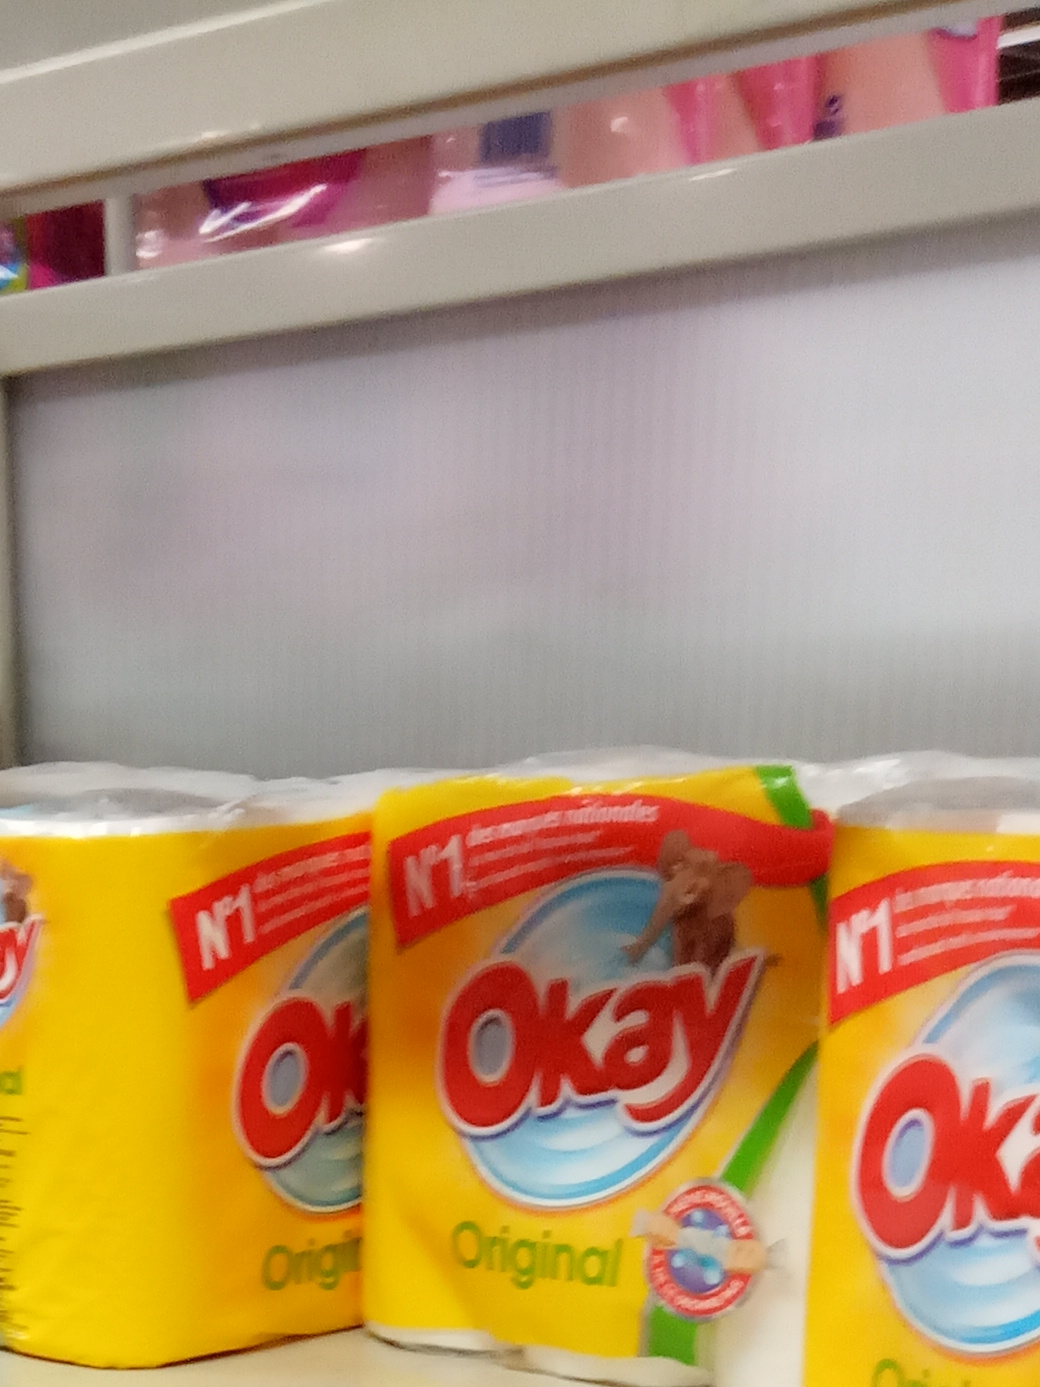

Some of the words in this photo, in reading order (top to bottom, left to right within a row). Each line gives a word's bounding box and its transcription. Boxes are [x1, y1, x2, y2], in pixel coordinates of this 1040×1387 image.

[235, 997, 368, 1165] Ok
[438, 950, 762, 1133] Okay
[452, 1220, 624, 1291] Original
